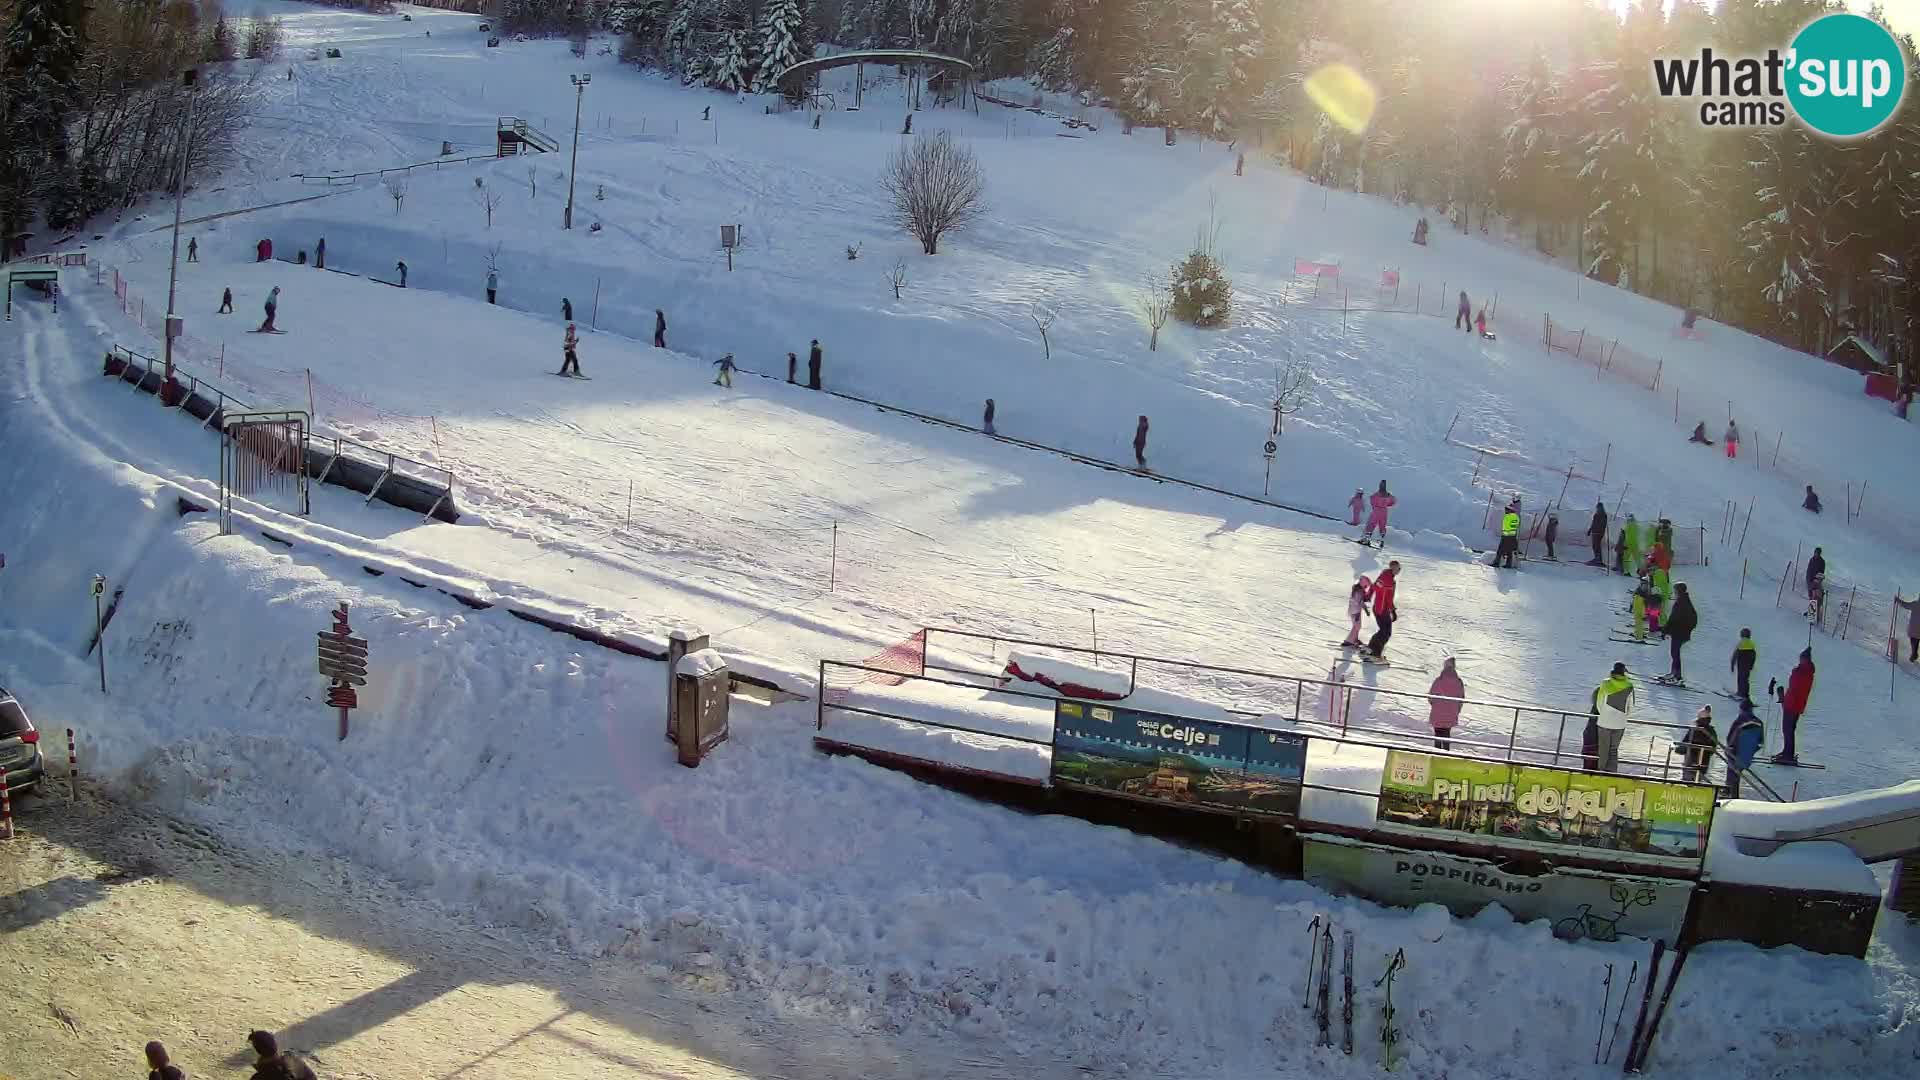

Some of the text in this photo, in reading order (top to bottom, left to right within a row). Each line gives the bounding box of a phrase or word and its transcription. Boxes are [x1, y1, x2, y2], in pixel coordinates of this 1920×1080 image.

[1160, 723, 1206, 746] Celje
[1433, 778, 1470, 801] Pri
[1396, 860, 1543, 894] PODPIRAMO
